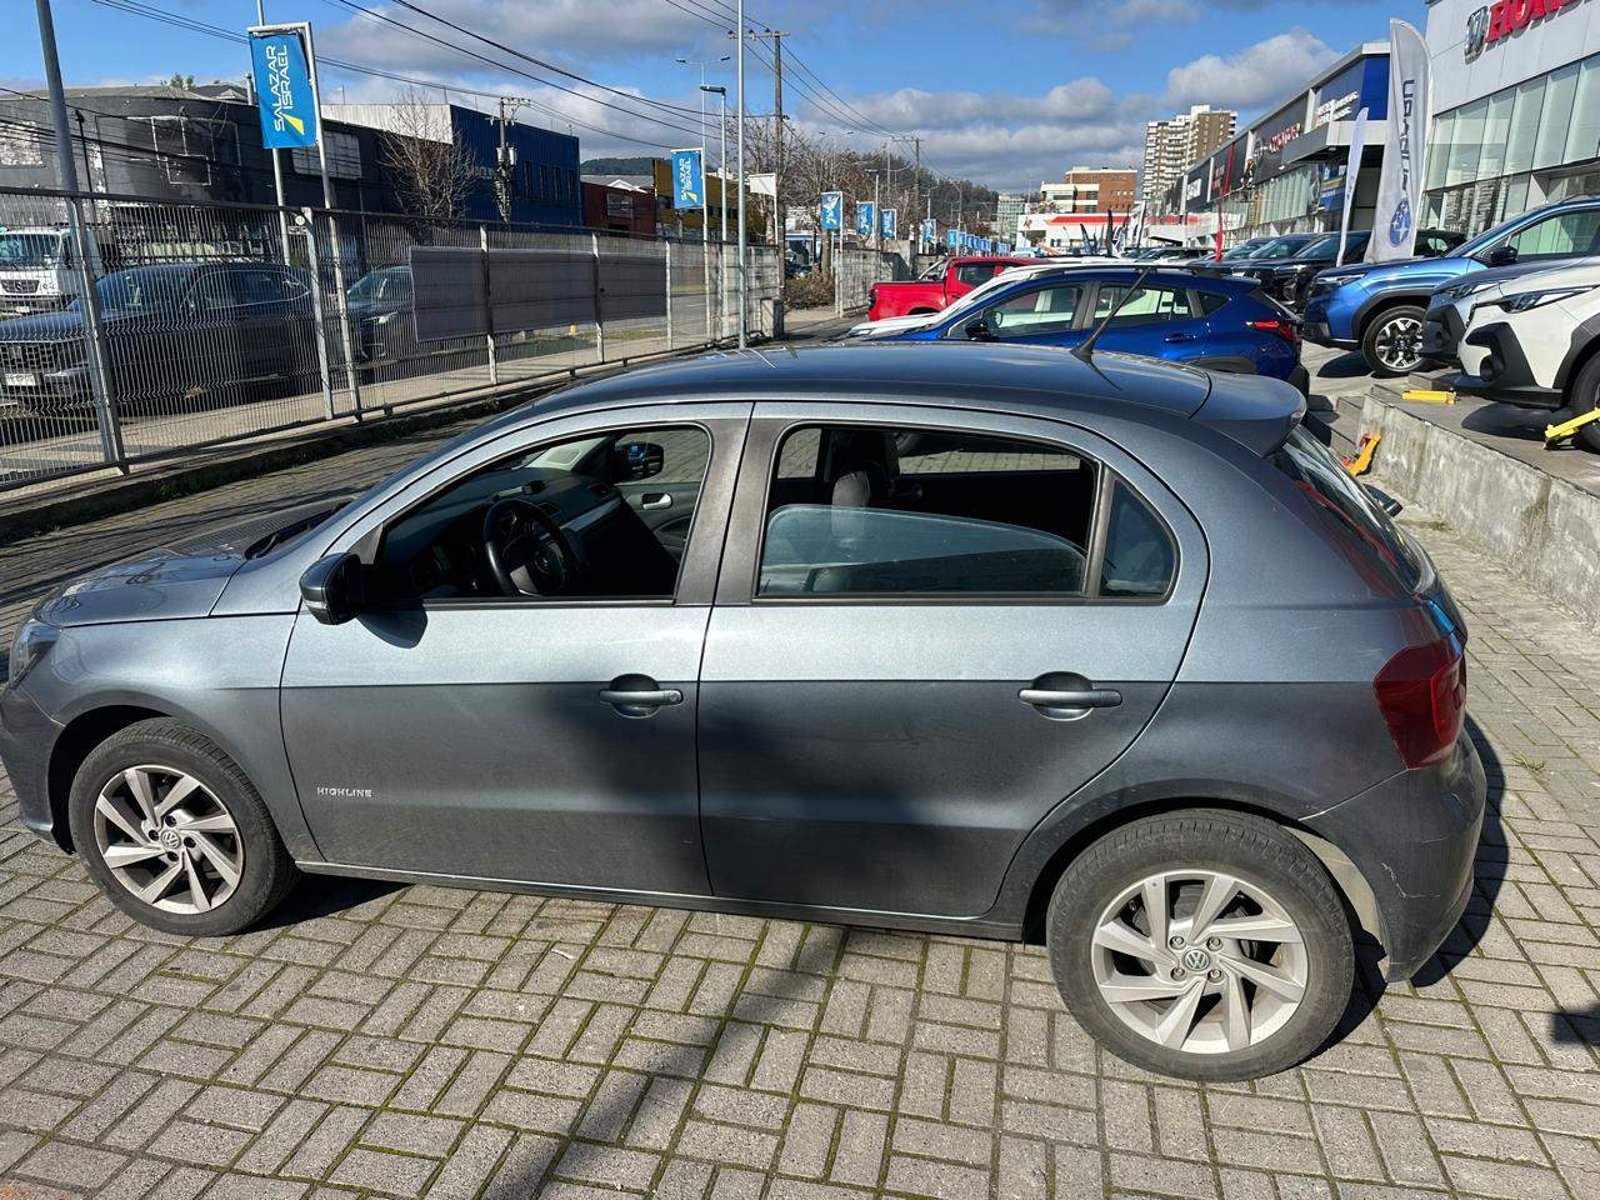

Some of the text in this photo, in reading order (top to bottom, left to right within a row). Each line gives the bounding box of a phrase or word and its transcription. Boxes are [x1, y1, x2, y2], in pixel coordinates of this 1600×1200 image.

[266, 45, 286, 132] SALAZAR
[277, 45, 294, 110] ISRAEL
[316, 786, 372, 797] HIGHLINE
